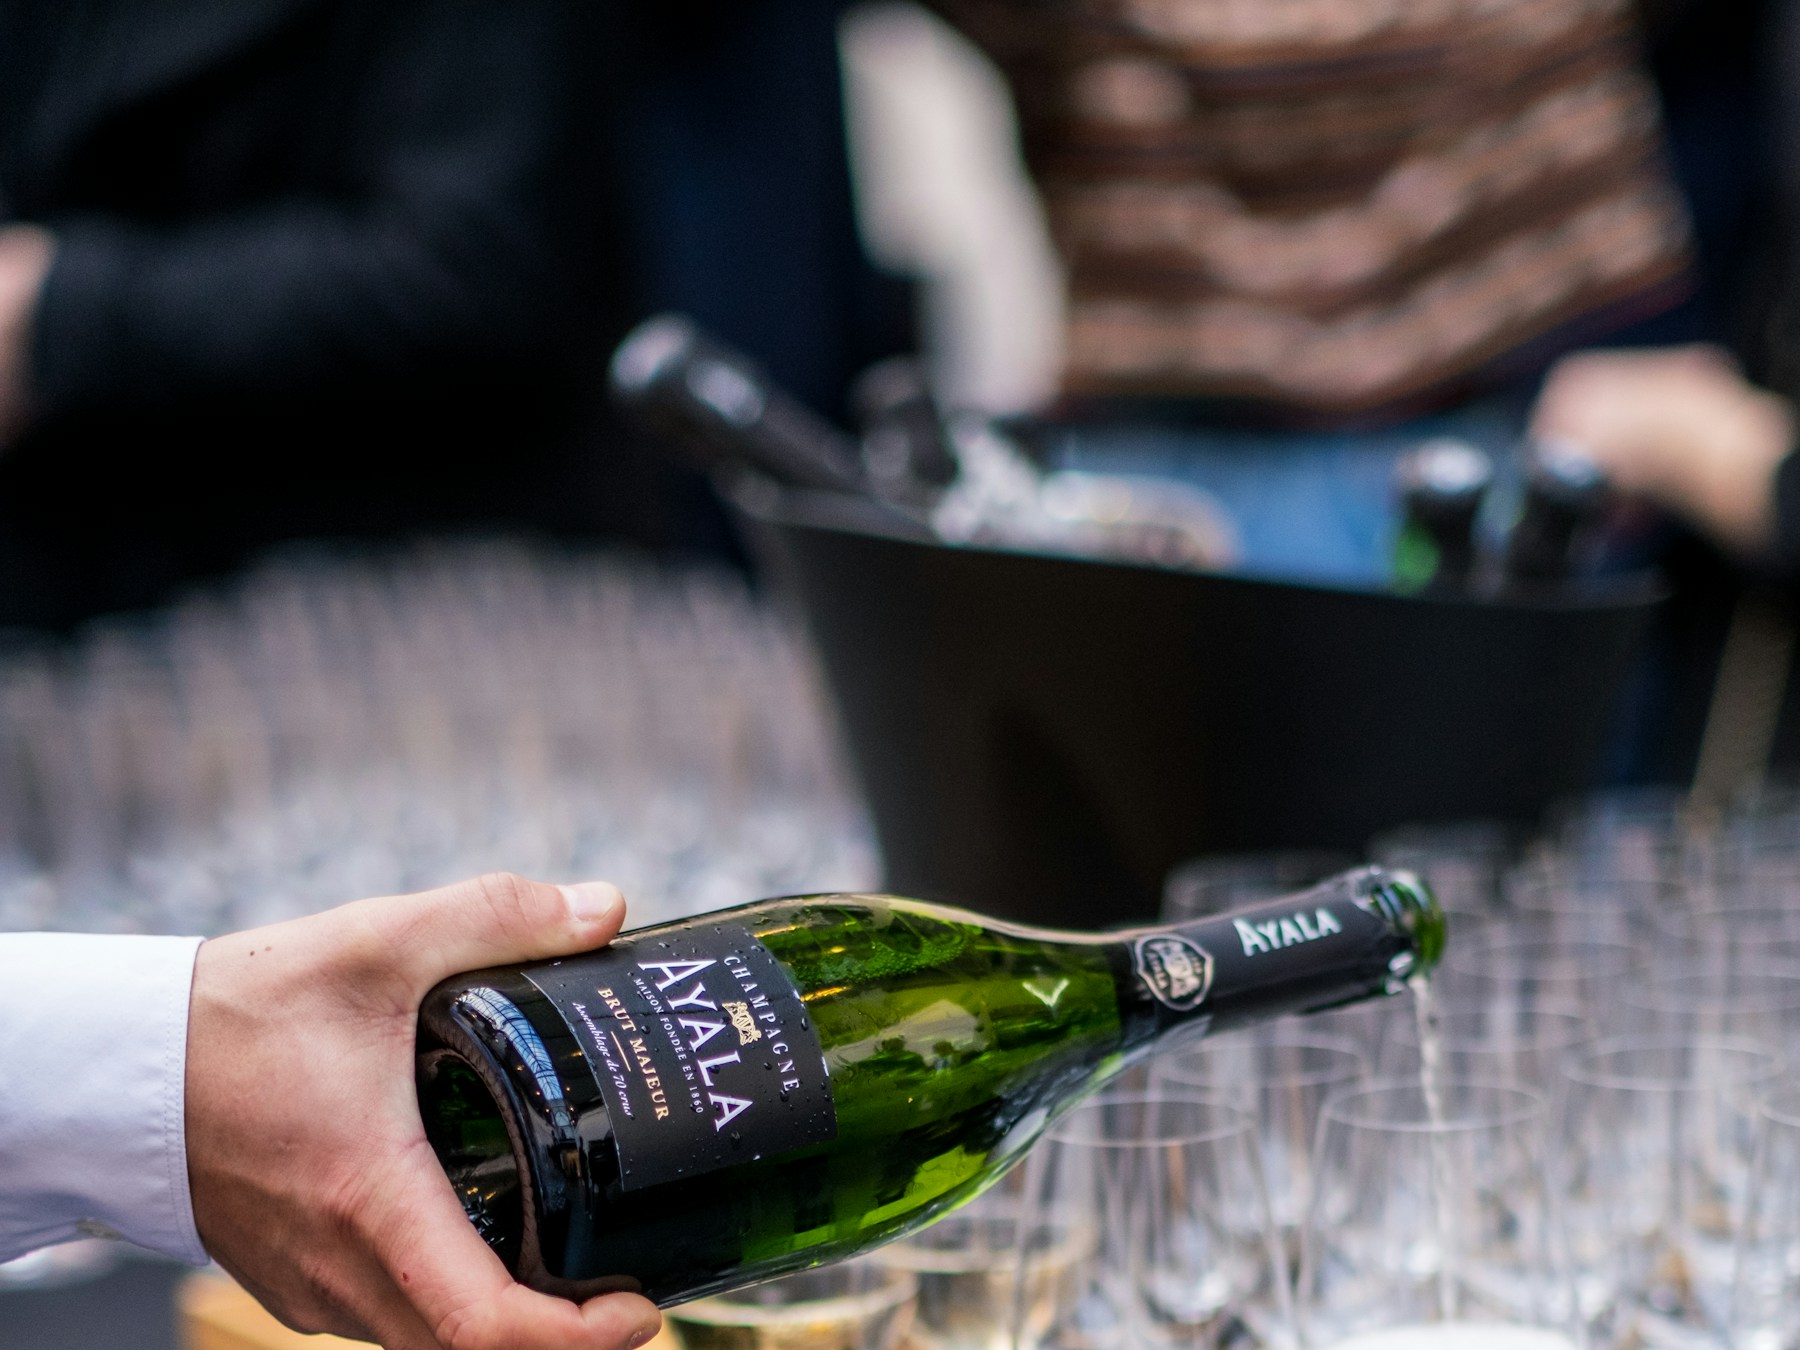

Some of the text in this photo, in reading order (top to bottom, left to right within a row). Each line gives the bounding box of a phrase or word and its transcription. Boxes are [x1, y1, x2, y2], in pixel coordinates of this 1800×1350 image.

[1233, 907, 1342, 957] AYALA
[597, 987, 670, 1121] BRUT MAJEUR
[606, 1059, 620, 1073] de
[633, 977, 704, 1114] MAISON FONDÉE EN 1860
[637, 959, 753, 1132] AYALA
[723, 955, 801, 1093] CHAMPAGNE
[612, 1074, 628, 1089] 70
[618, 1090, 634, 1117] crus
